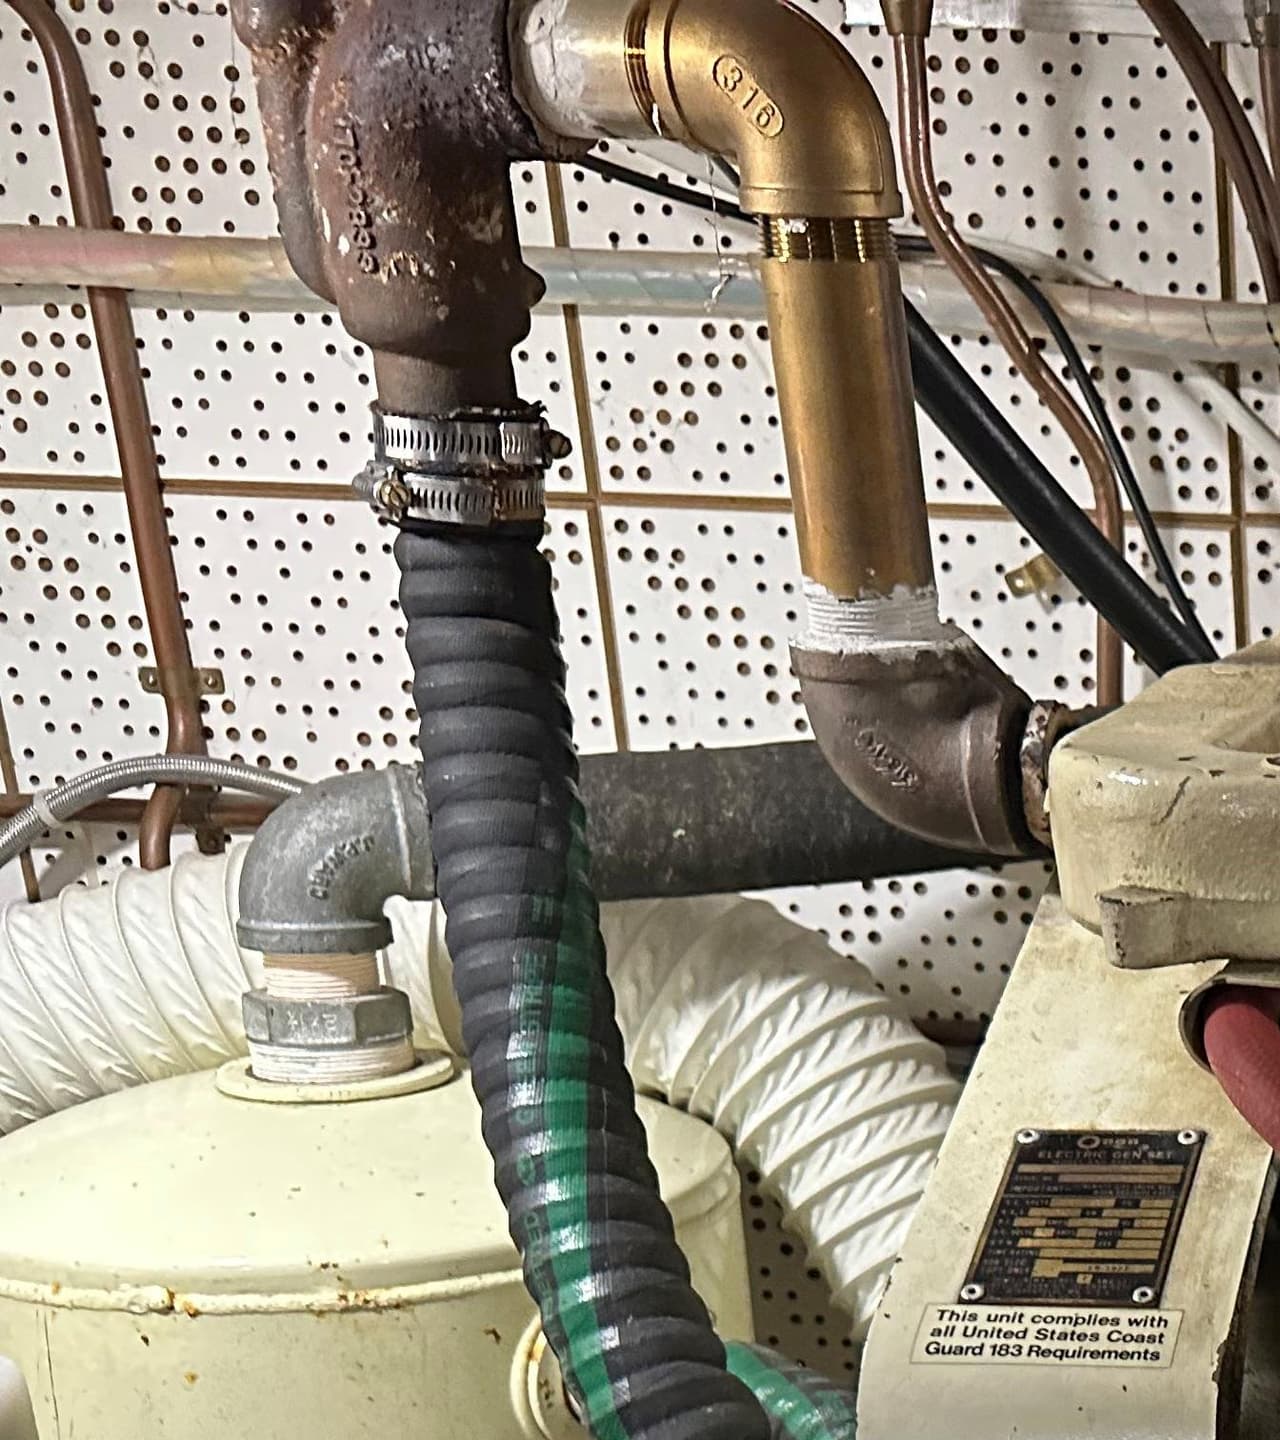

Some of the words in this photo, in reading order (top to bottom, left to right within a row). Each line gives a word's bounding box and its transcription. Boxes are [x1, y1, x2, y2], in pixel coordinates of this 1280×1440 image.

[721, 63, 778, 130] 316
[936, 1309, 979, 1323] This
[986, 1310, 1024, 1325] unit
[1030, 1311, 1121, 1329] complies
[1127, 1315, 1169, 1329] with
[930, 1324, 955, 1338] all
[962, 1326, 1028, 1340] United
[1034, 1327, 1100, 1343] States
[1106, 1330, 1165, 1345] Coast
[924, 1341, 984, 1357] Guard
[989, 1342, 1023, 1358] 183
[1027, 1344, 1162, 1361] Requirements
